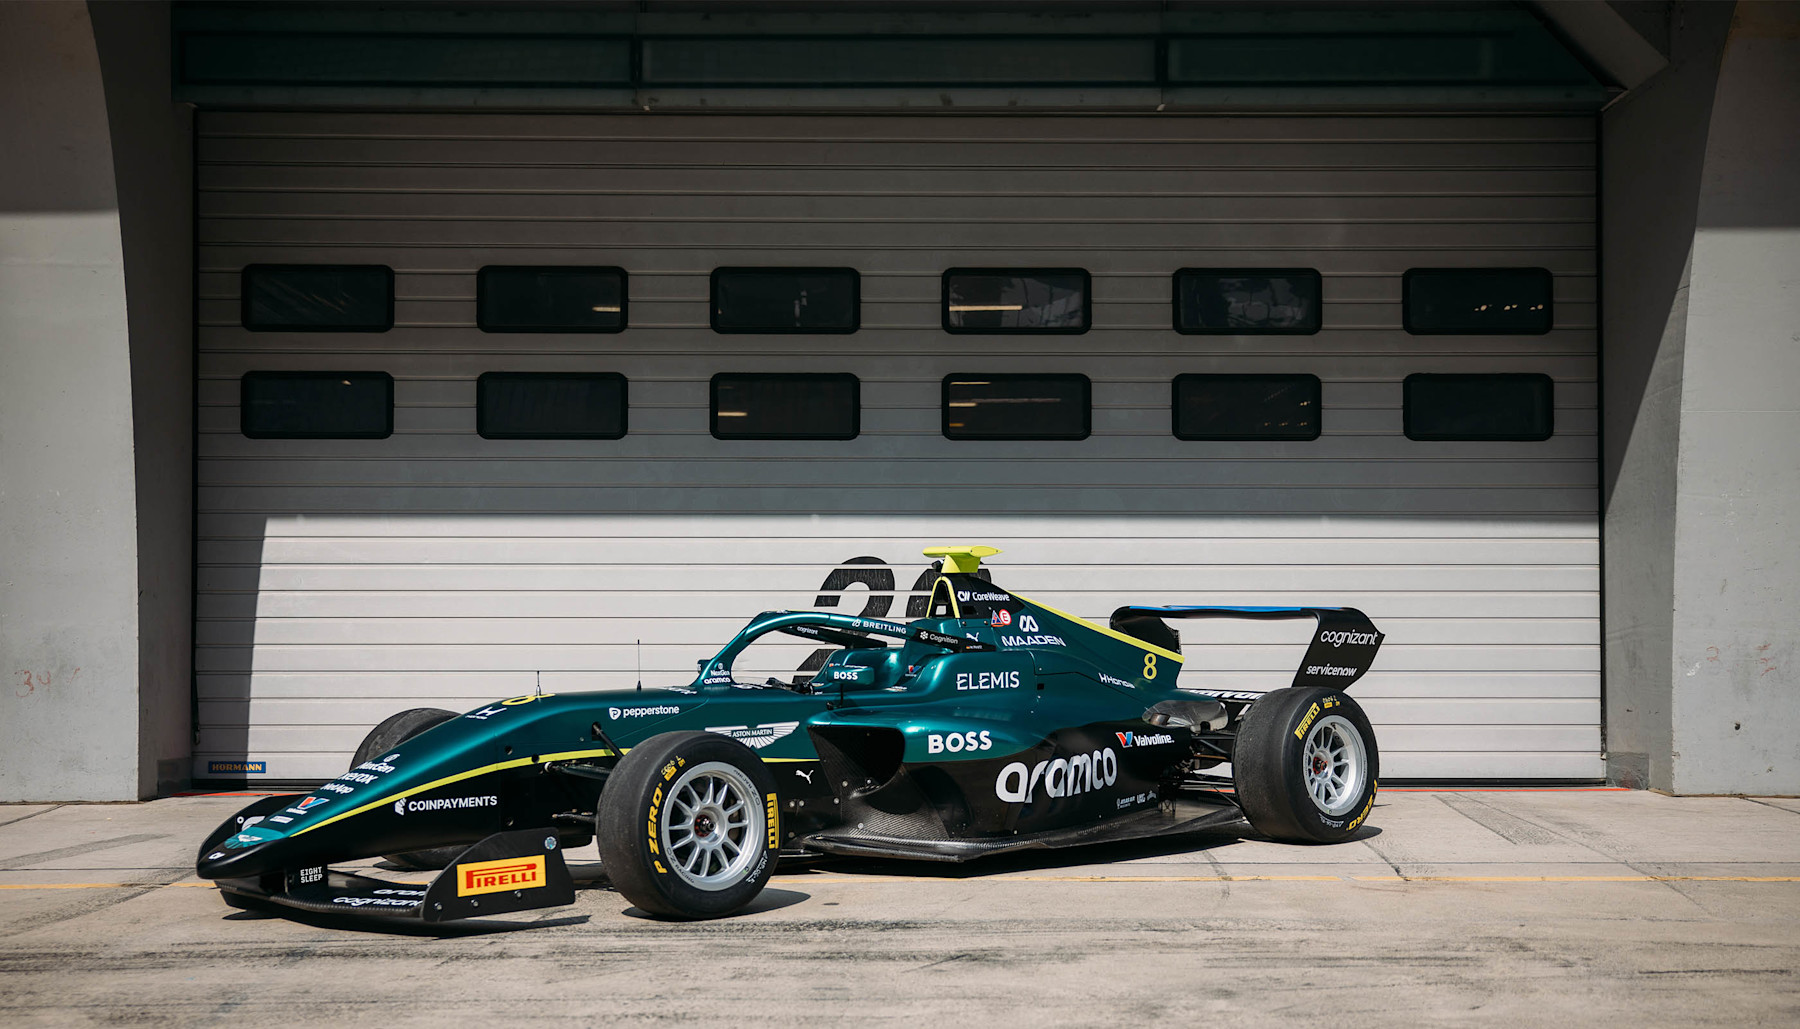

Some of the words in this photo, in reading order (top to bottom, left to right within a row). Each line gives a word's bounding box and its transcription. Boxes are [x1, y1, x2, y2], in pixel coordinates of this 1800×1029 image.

[972, 592, 1010, 602] CoreWeave
[863, 621, 907, 635] BREITLING
[929, 633, 959, 645] Cognition
[1002, 635, 1067, 647] MAADEN
[1320, 629, 1378, 648] cognizant
[1142, 653, 1158, 680] 8
[1306, 663, 1357, 677] servicenow
[704, 677, 732, 685] aramco
[834, 671, 858, 680] BOSS
[957, 671, 1020, 691] ELEMIS
[623, 706, 680, 718] pepperstone
[1294, 702, 1320, 740] PIRELLI
[732, 730, 751, 738] ASTON
[928, 730, 993, 754] BOSS
[995, 747, 1117, 803] aramco
[408, 796, 498, 812] COINPAYMENTS
[648, 787, 662, 855] ZERO
[766, 793, 779, 849] PIRELLI
[300, 866, 323, 876] EIGHT
[654, 860, 668, 873] P
[300, 874, 323, 884] SLEEP
[465, 863, 537, 890] PIRELLI
